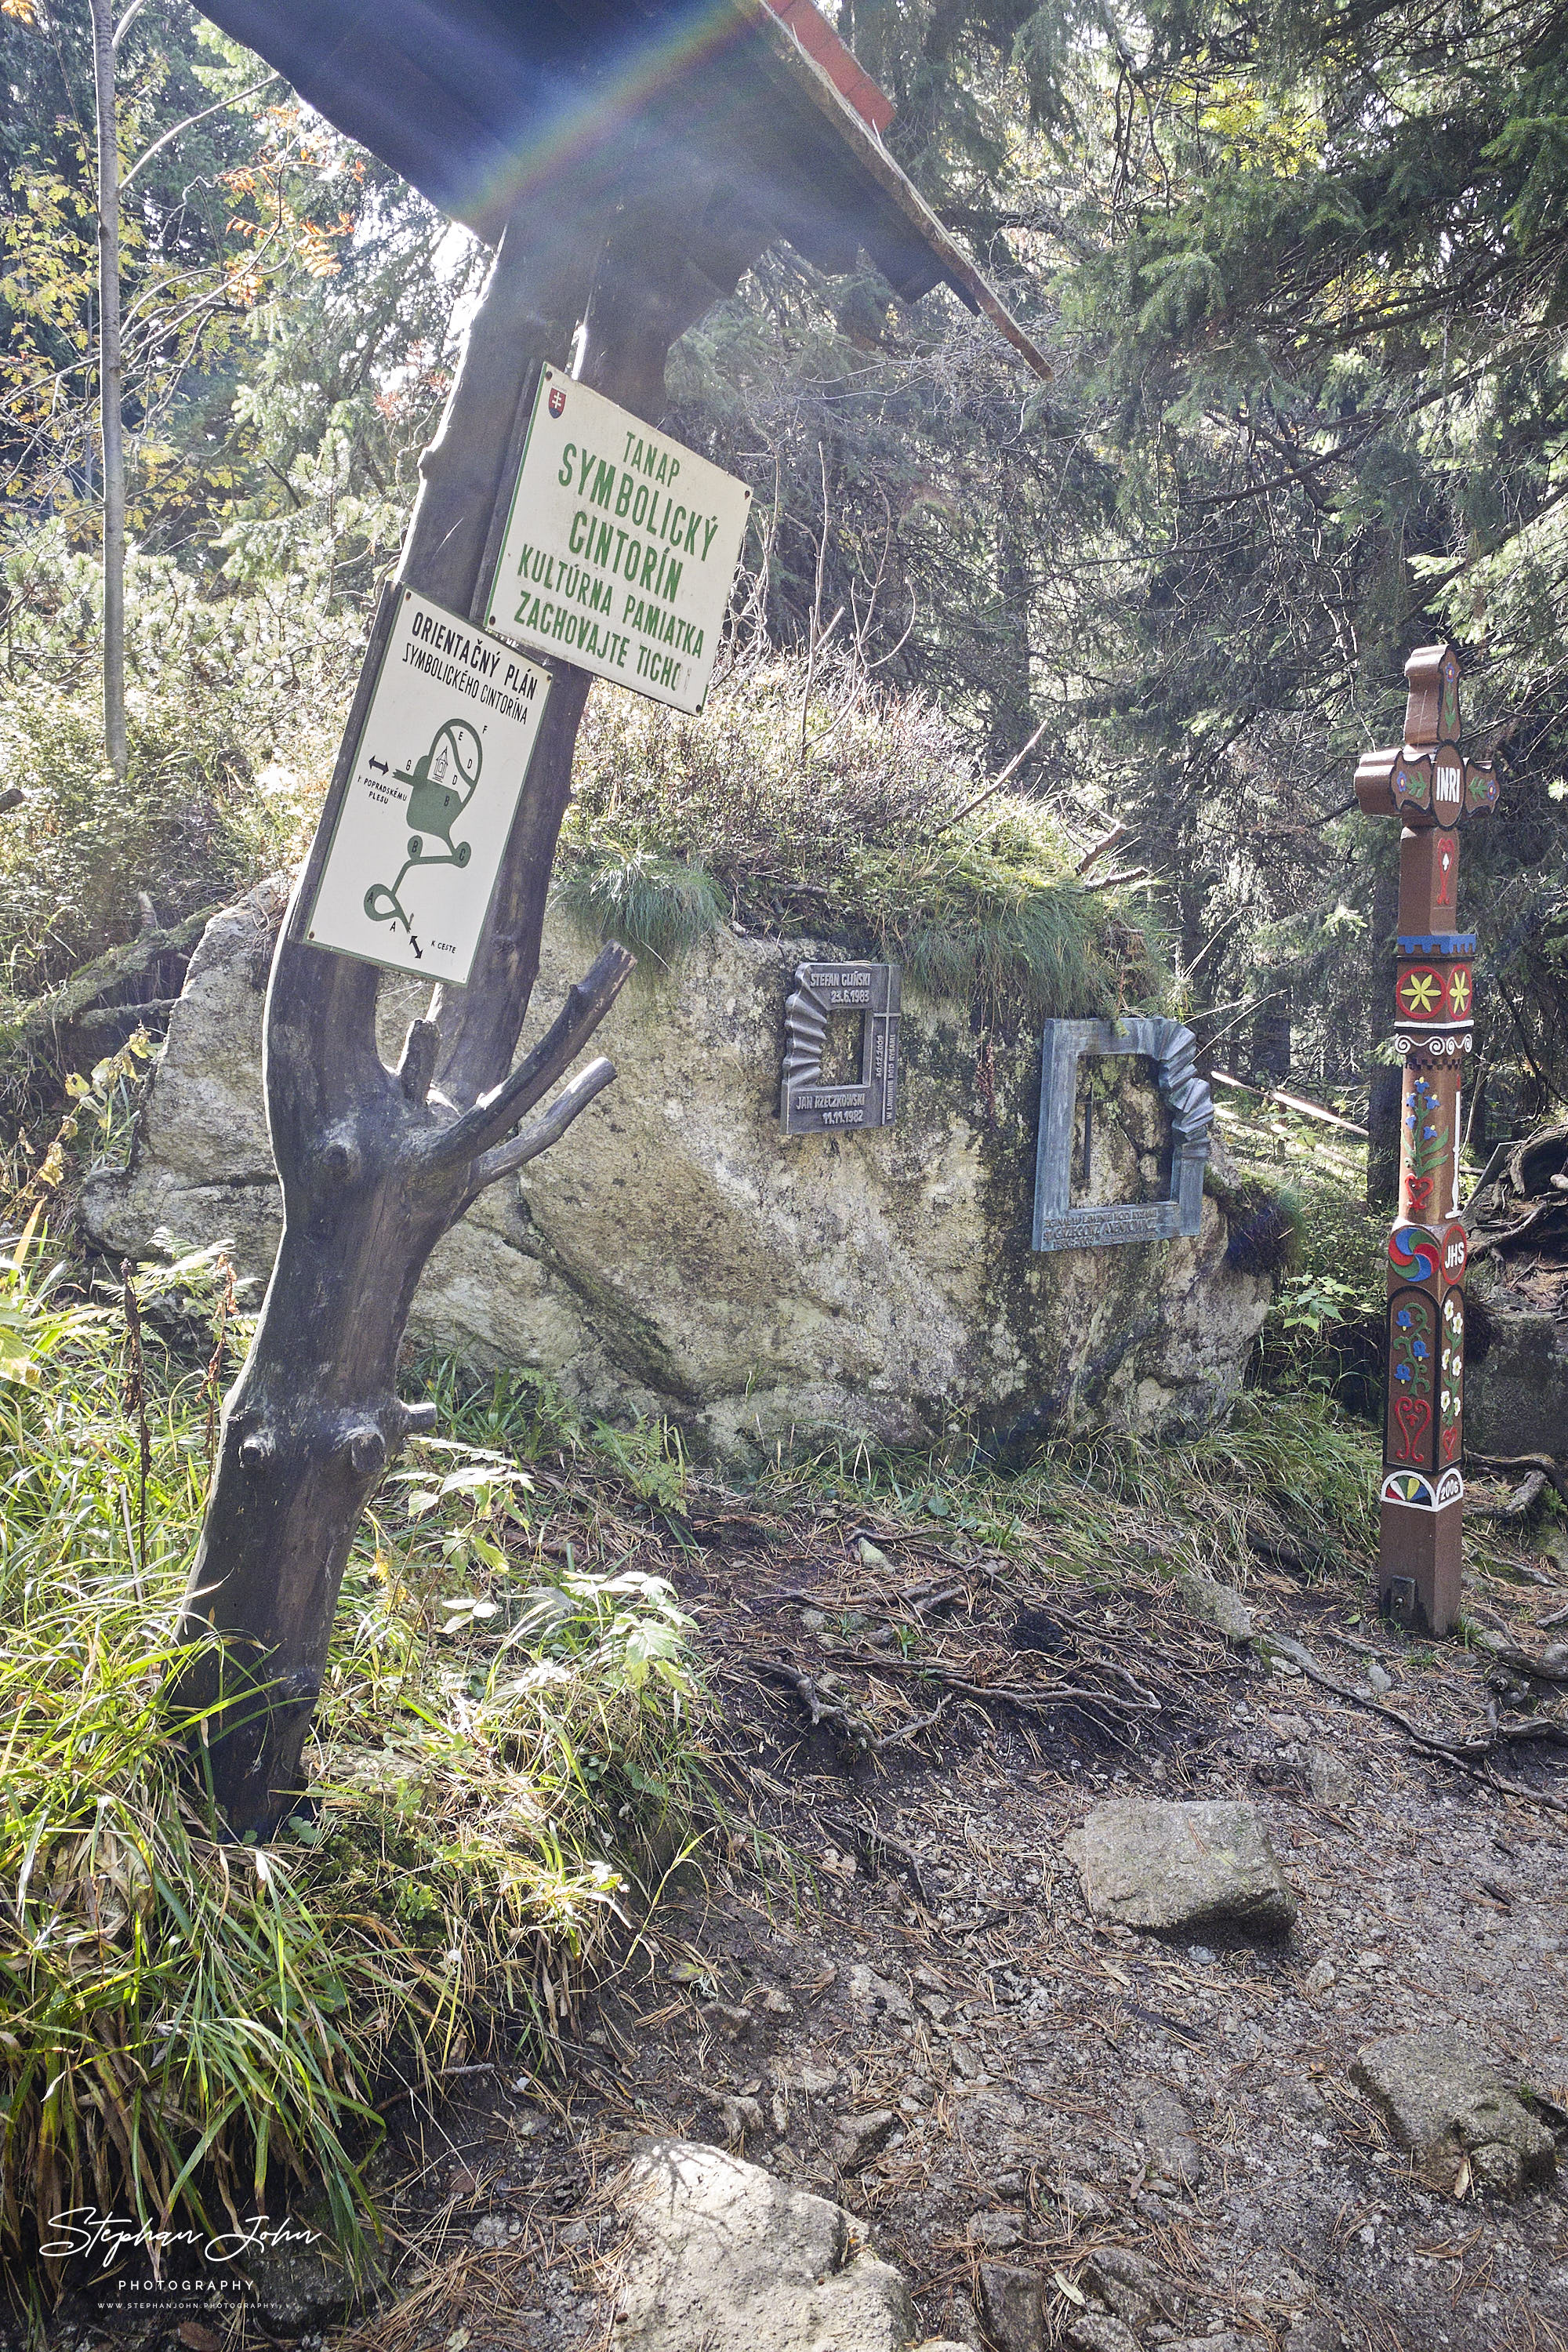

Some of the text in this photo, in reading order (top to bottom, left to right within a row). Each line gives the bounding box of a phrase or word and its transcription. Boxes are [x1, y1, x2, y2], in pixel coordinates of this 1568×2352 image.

[623, 431, 681, 488] TANAP
[558, 443, 718, 561] SYMBOLICKÝ
[568, 510, 684, 603] CINTORÍN
[517, 543, 704, 659] KULTÚRNA PAMIATKA
[514, 590, 630, 668] ZACHOVAJTE
[412, 612, 538, 700] ORIENTAČNÝ PLÁN
[402, 642, 528, 724] SYMBOLICKÉHO CINTORÍNA
[458, 731, 463, 741] E
[483, 725, 488, 734] F
[467, 758, 473, 769] D
[452, 775, 458, 786] D
[1436, 766, 1461, 804] INRI
[363, 778, 408, 801] POPRADSKÉMU
[368, 791, 389, 804] PLESU
[444, 796, 450, 807] B
[412, 840, 419, 853] B
[459, 848, 466, 861] C
[367, 891, 374, 904] A
[390, 921, 396, 932] A
[437, 942, 457, 954] CESTE
[810, 973, 840, 987] STEFAN
[796, 1096, 813, 1110] JAN
[1444, 1241, 1465, 1269] JHS
[1440, 1479, 1459, 1501] 2006
